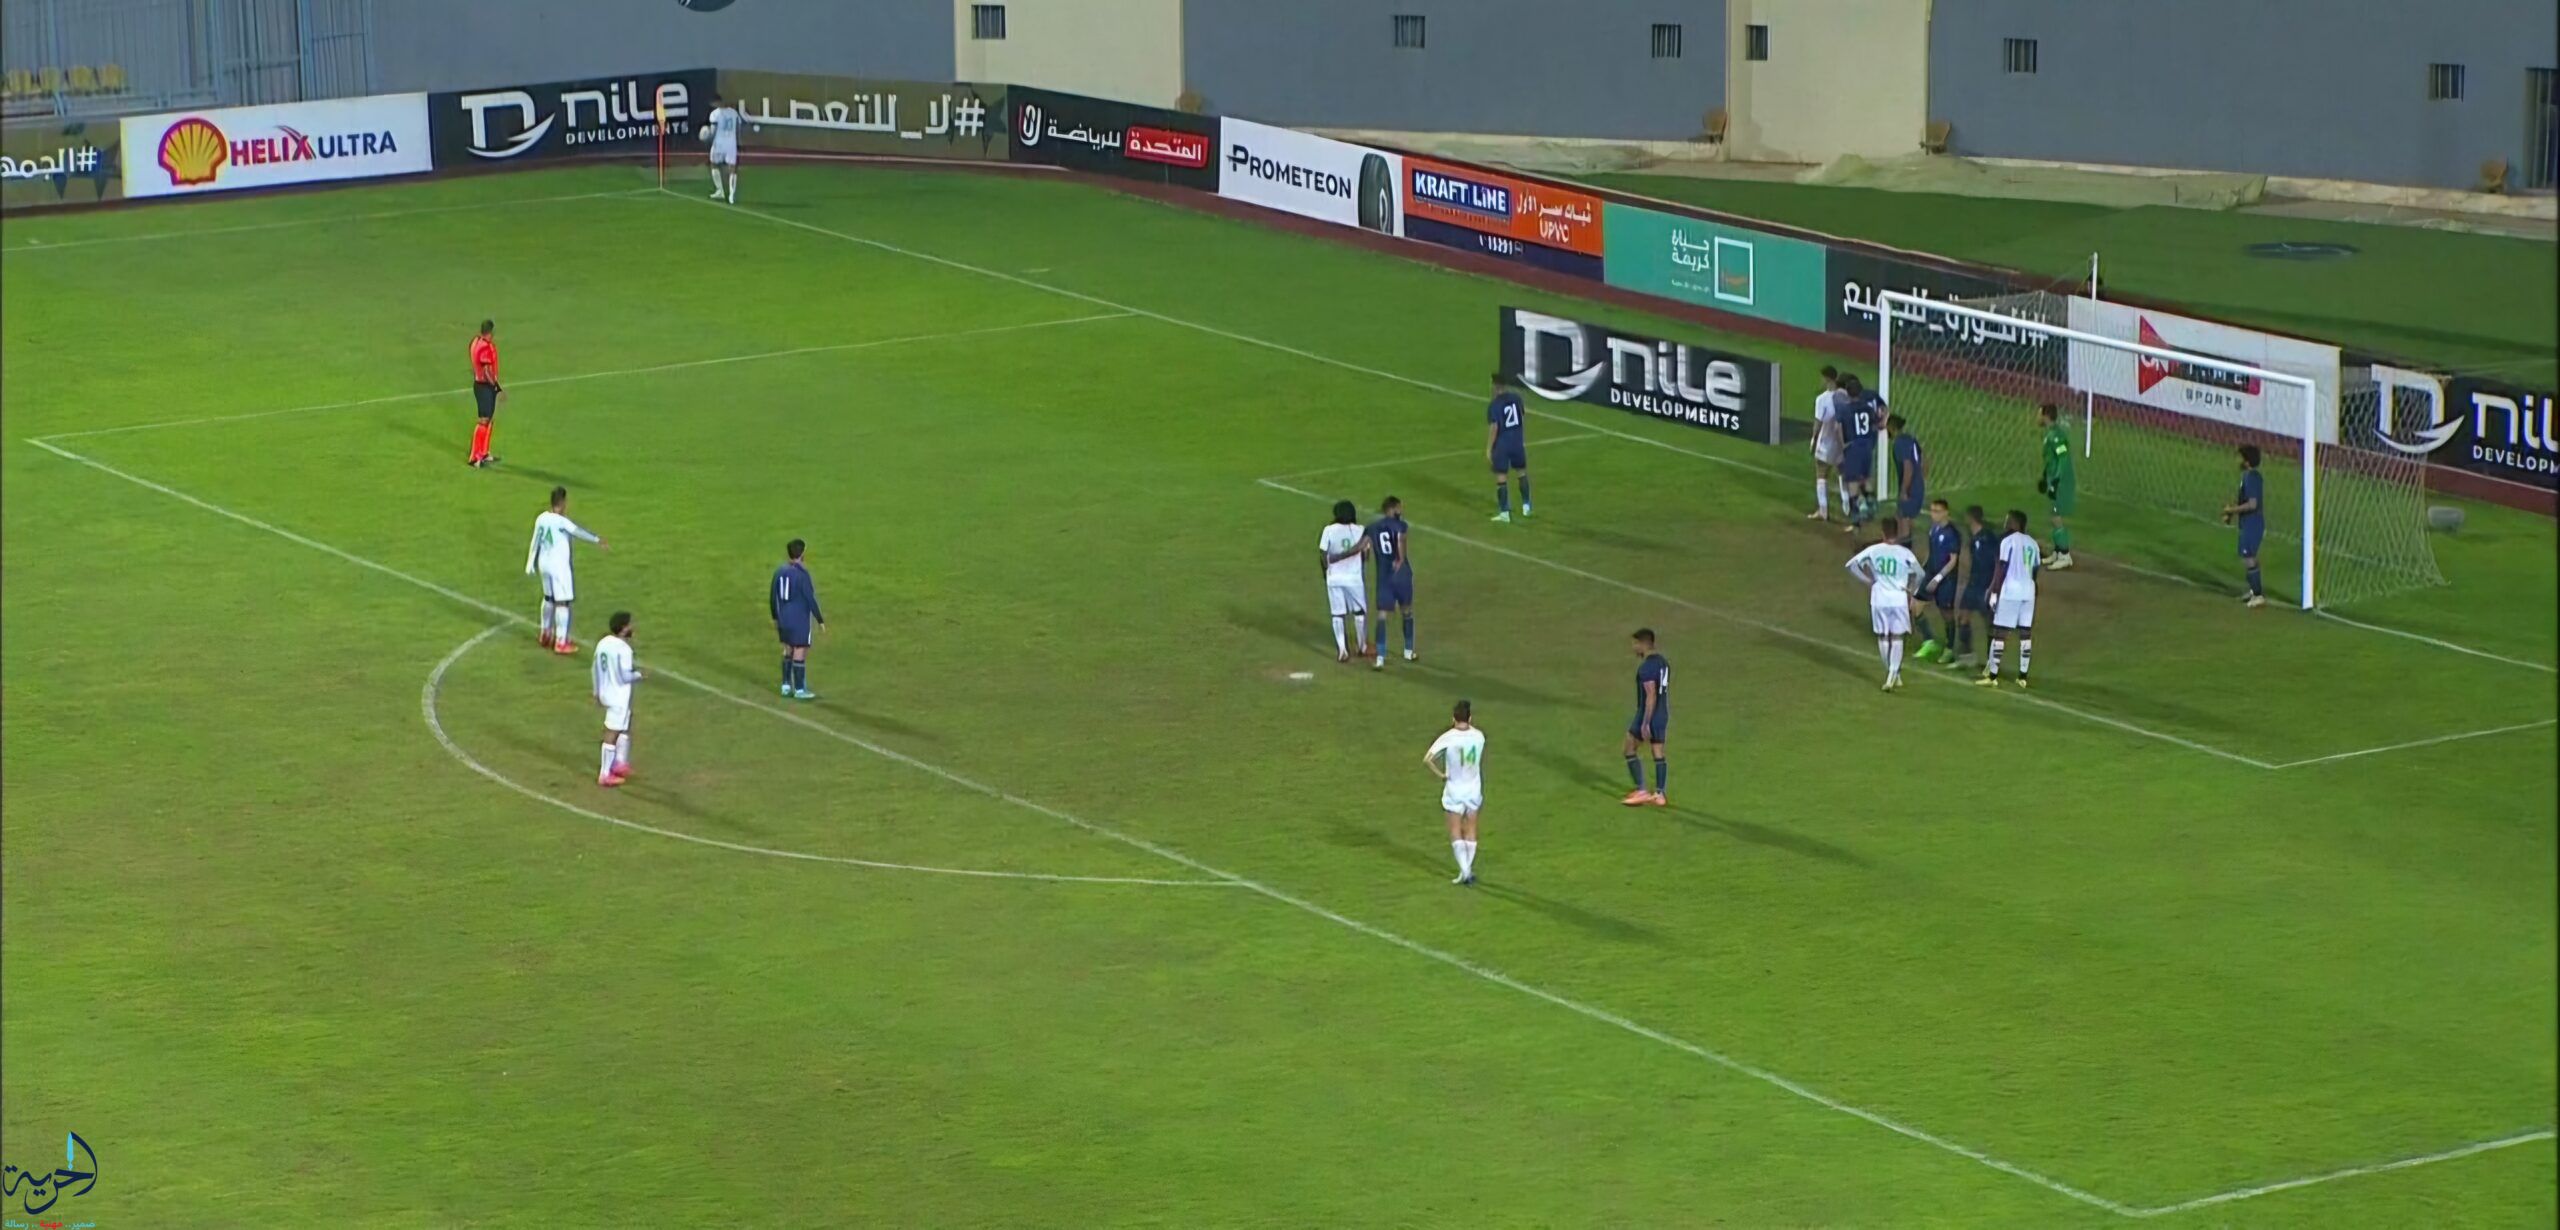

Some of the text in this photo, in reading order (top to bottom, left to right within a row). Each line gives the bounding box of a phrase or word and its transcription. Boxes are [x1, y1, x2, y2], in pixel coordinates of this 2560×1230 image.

[230, 130, 397, 166] HELIX ULTRA
[1047, 118, 1201, 161] المتحدة للرياضة
[1227, 144, 1351, 199] PROMETEON
[1415, 172, 1469, 203] KRAFT
[1607, 337, 1746, 412] nile
[1503, 402, 1519, 428] 21
[1610, 386, 1740, 431] DEVELOPMENTS
[1855, 412, 1870, 436] 13
[1379, 531, 1393, 555] 6
[1876, 555, 1898, 577] 30
[779, 576, 791, 601] 11
[1459, 744, 1477, 768] 14
